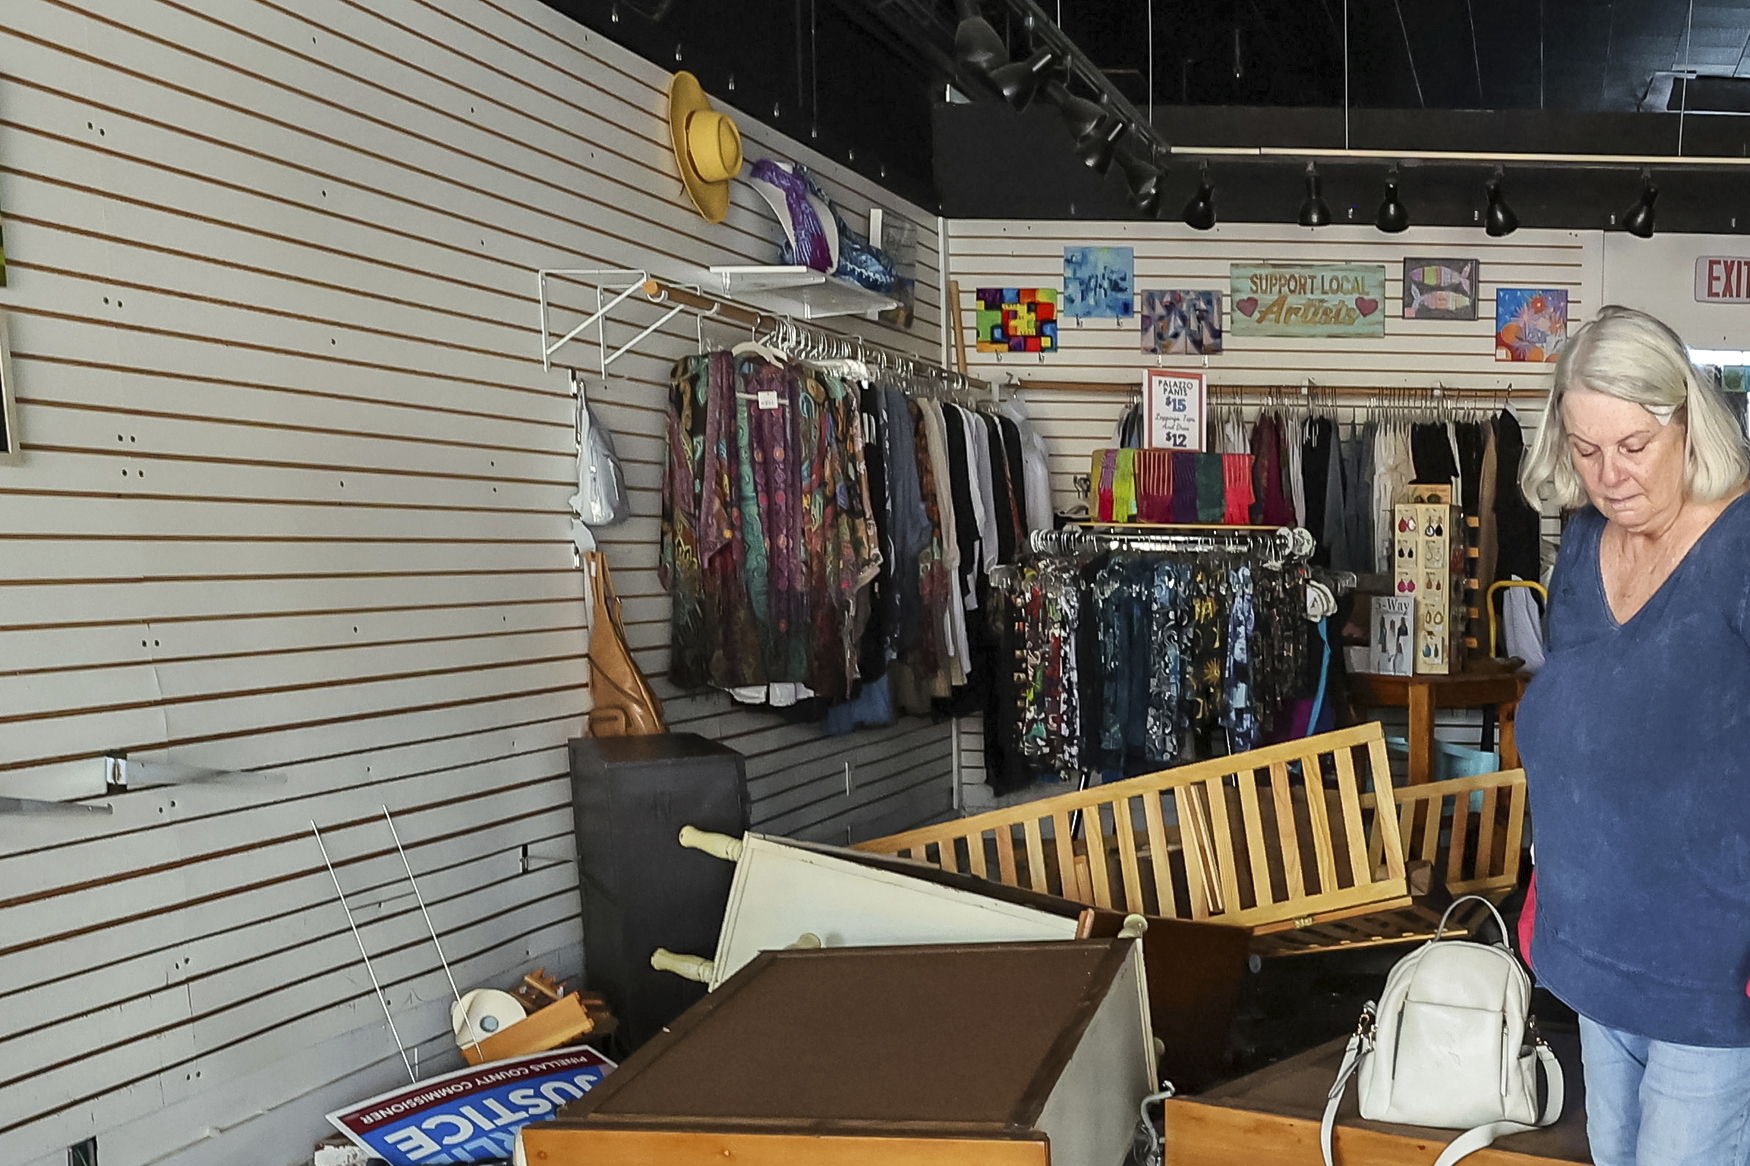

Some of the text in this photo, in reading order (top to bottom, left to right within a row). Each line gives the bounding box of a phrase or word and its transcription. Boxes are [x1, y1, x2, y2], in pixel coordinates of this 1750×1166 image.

[1250, 273, 1370, 296] SUPPORT LOCAL
[1256, 295, 1361, 325] Artists
[1158, 379, 1194, 391] PALAZZO
[1163, 386, 1188, 397] PANTS
[1165, 395, 1187, 412] $15
[1165, 431, 1187, 448] $12
[359, 1055, 588, 1125] PINELLAS COUNTY COMMISSIONER
[384, 1074, 599, 1161] JUSTICE
